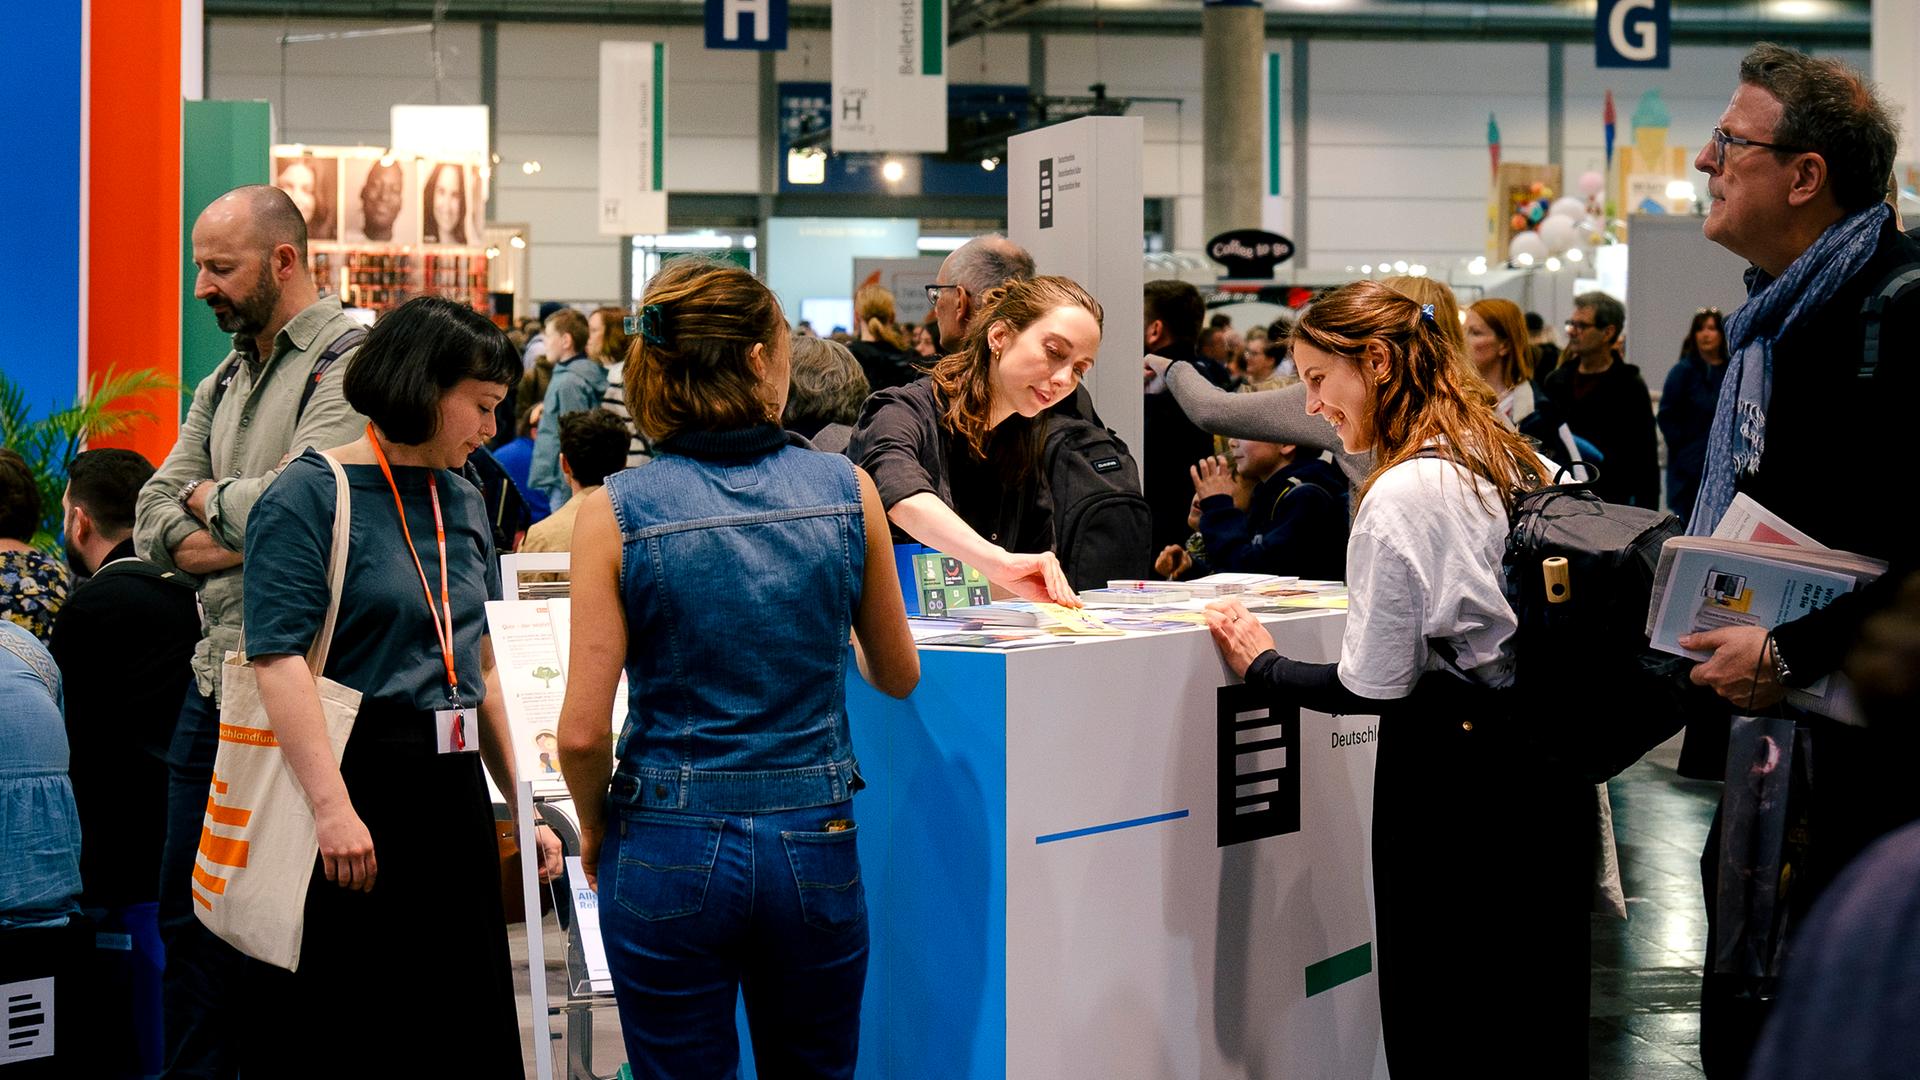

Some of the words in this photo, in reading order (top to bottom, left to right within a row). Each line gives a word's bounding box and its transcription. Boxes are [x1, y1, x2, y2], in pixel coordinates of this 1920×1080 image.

[723, 0, 770, 41] H
[1608, 0, 1657, 61] G
[842, 98, 861, 120] H
[1212, 239, 1254, 259] Coffee
[1255, 243, 1270, 256] to
[1272, 243, 1289, 257] go
[1801, 582, 1812, 595] für
[1812, 584, 1823, 599] das
[1799, 595, 1809, 609] Sie
[1331, 724, 1379, 749] Deutschl
